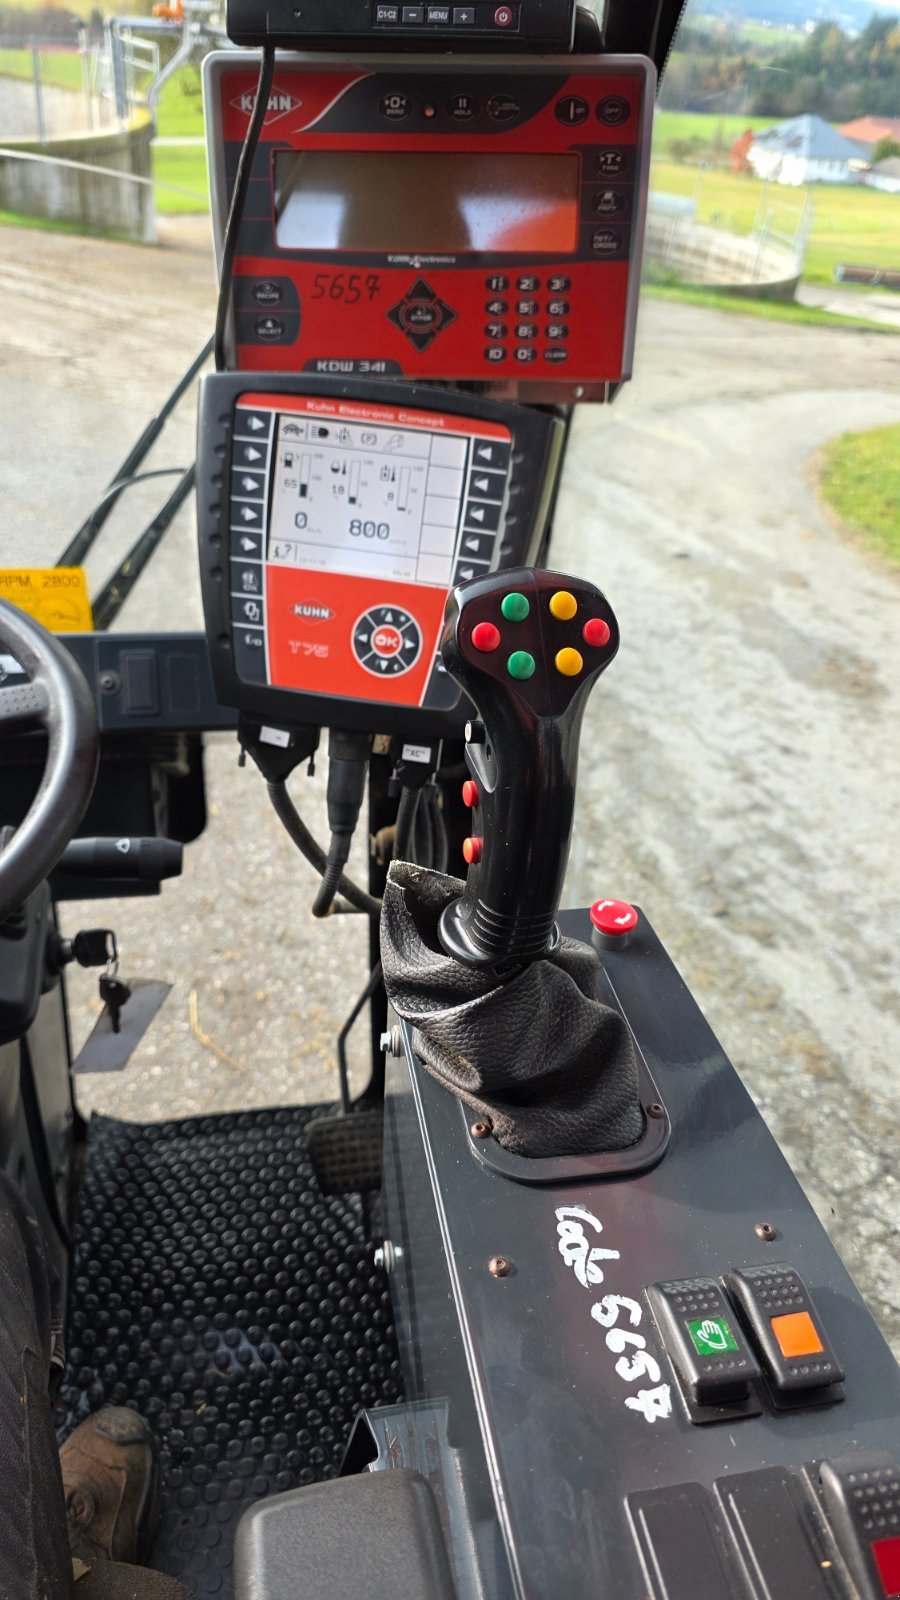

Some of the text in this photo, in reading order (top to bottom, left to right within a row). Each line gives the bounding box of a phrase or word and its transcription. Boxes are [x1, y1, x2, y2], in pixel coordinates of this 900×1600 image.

[429, 11, 448, 20] MENU
[240, 95, 292, 111] KHN
[310, 273, 380, 305] 5657
[316, 360, 354, 372] KDW
[306, 401, 445, 427] Kuhn Electronic Concept
[295, 511, 308, 529] 0
[349, 519, 390, 540] 800
[41, 574, 80, 588] 2800
[294, 603, 330, 619] KUHN
[374, 633, 398, 647] OK
[590, 1294, 672, 1424] 5657
